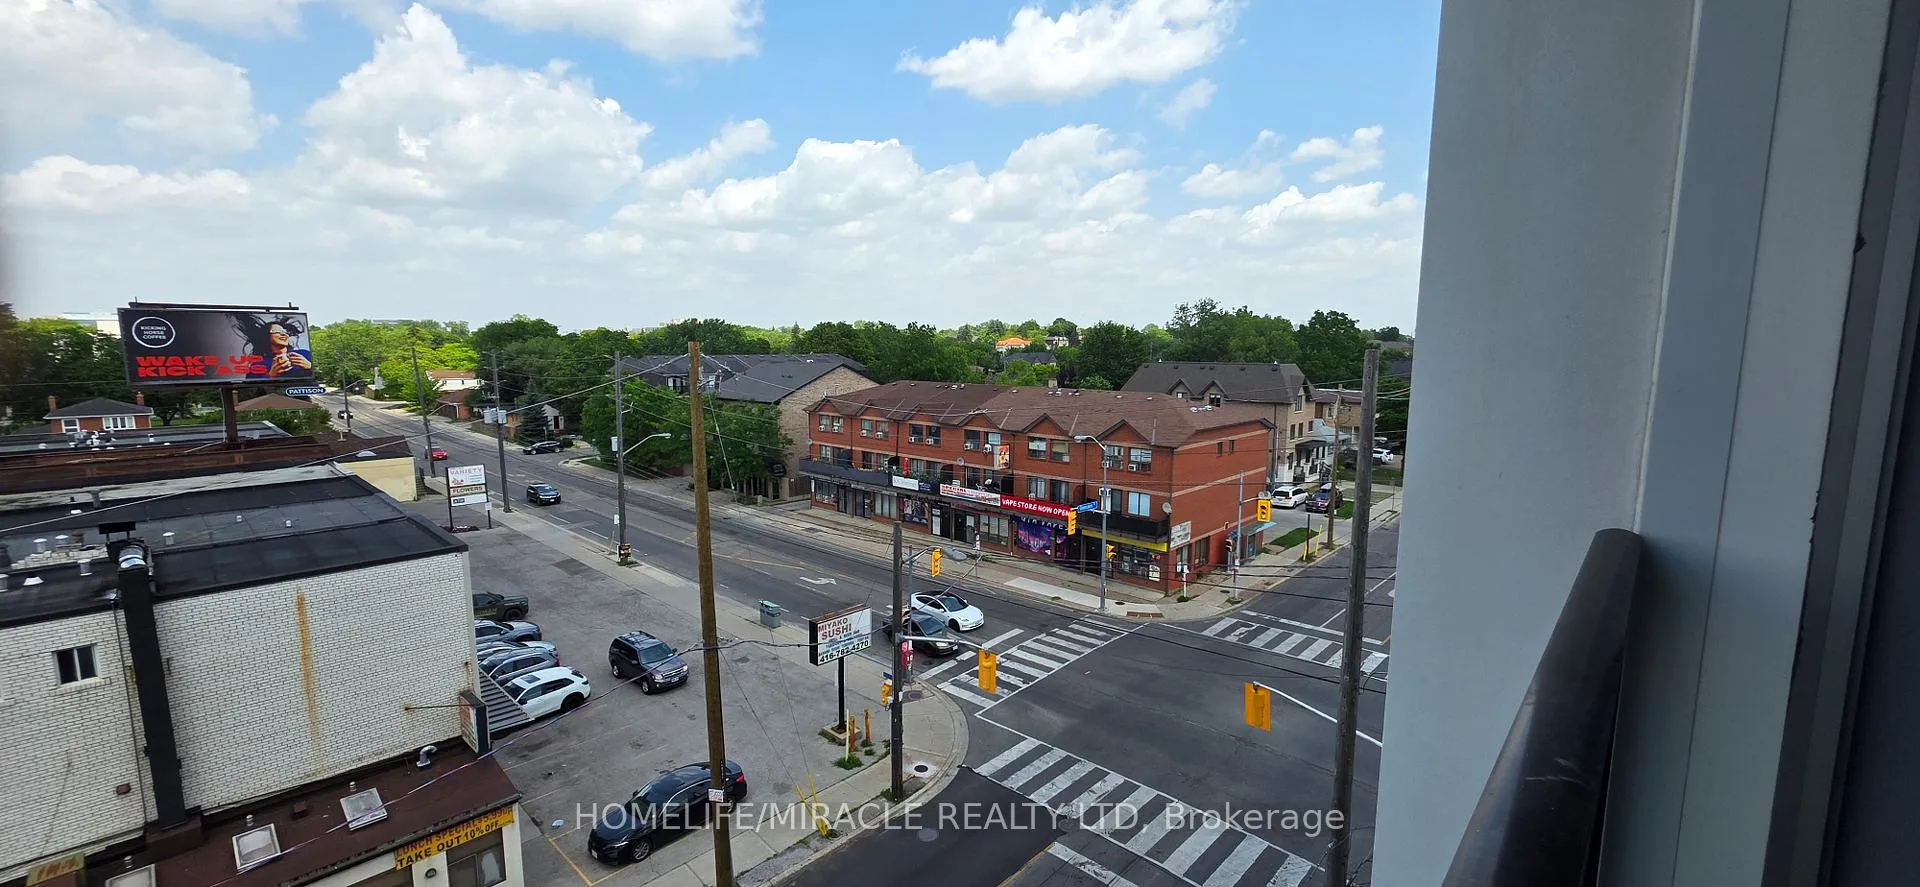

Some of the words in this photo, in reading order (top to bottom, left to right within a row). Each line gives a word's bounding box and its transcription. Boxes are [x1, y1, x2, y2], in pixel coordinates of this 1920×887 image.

[135, 355, 220, 366] WAKE
[228, 354, 263, 365] UP
[137, 365, 207, 377] KICK
[215, 364, 268, 375] ASS
[288, 387, 325, 395] PATTISON
[450, 467, 482, 475] VARIETY
[1002, 498, 1017, 507] VAPE
[1018, 501, 1037, 511] STORE
[1038, 505, 1053, 514] NOW
[1052, 507, 1070, 517] OPEN
[818, 617, 849, 632] MIYAKO
[821, 623, 852, 640] SUSHI
[395, 835, 433, 858] LUNCH
[396, 847, 432, 868] TAKE
[437, 835, 462, 852] OUT
[464, 826, 485, 841] 10%
